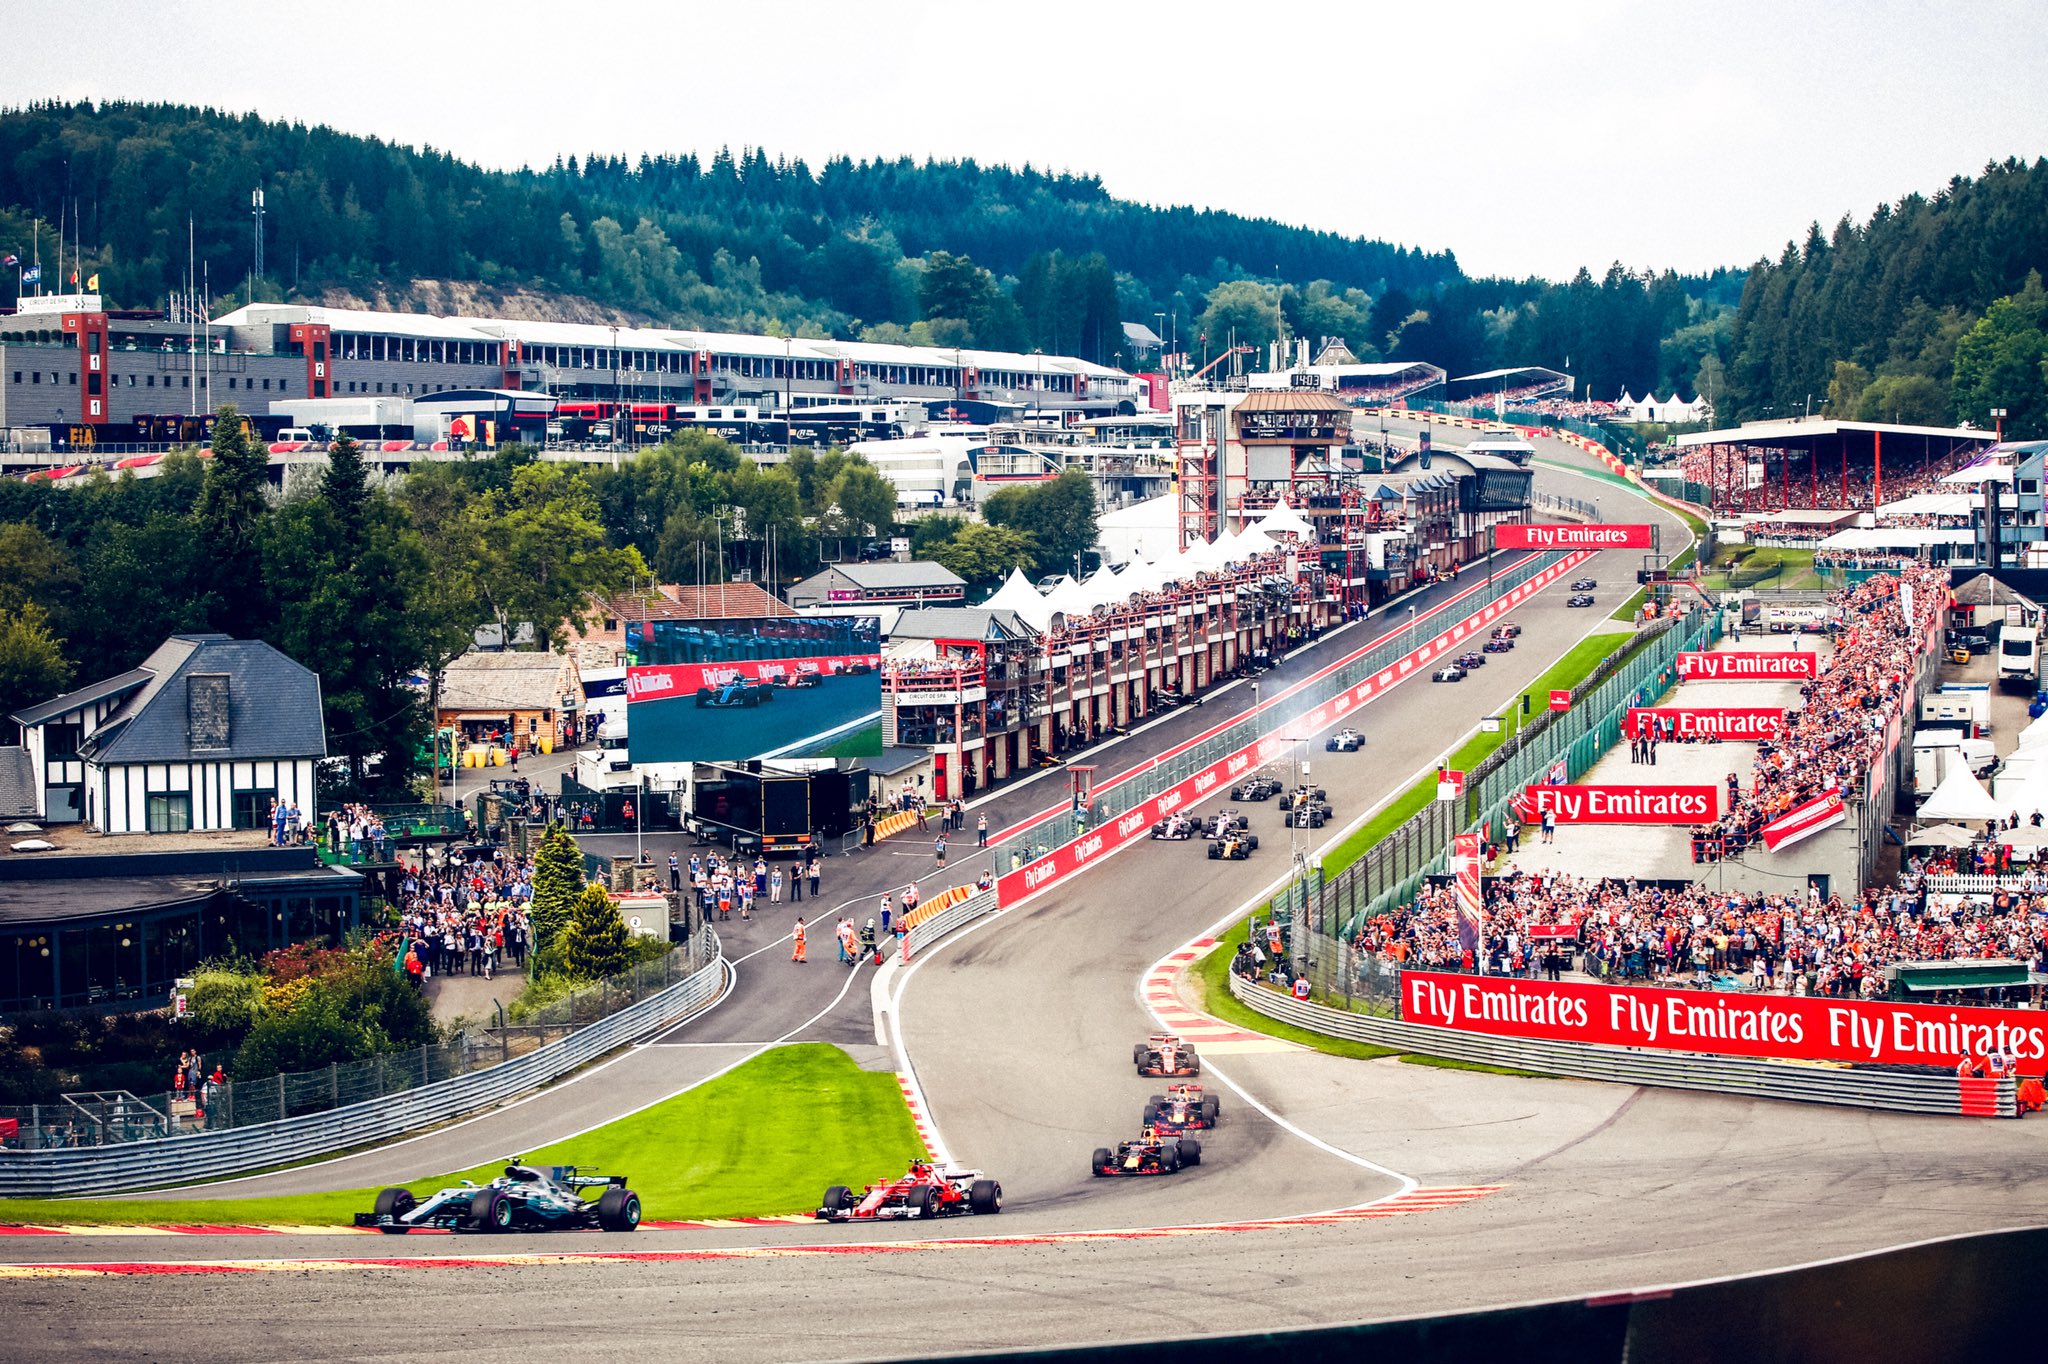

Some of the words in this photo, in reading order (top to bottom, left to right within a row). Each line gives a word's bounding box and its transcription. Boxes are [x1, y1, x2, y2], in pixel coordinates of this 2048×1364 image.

[92, 357, 98, 369] 1
[318, 365, 322, 376] 2
[1295, 375, 1319, 386] 14:03
[93, 402, 98, 414] 1
[1527, 528, 1554, 545] Fly
[1557, 527, 1628, 543] Emirates
[1685, 655, 1718, 677] Fly
[1722, 655, 1809, 673] Emirates
[1679, 712, 1779, 733] Emirates
[1536, 790, 1582, 819] Fly
[1588, 789, 1708, 815] Emirates
[1118, 820, 1128, 838] Fly
[1125, 811, 1145, 833] Emirates
[1074, 844, 1085, 863] Fly
[1082, 835, 1103, 858] Emirates
[1025, 870, 1036, 889] Fly
[1033, 860, 1056, 884] Emirates
[1411, 979, 1457, 1025] Fly
[1462, 984, 1588, 1027] Emirates
[1609, 993, 1660, 1041] Fly
[1666, 998, 1804, 1044] Emirates
[1828, 1007, 1885, 1058] Fly
[1892, 1012, 2045, 1060] Emirates
